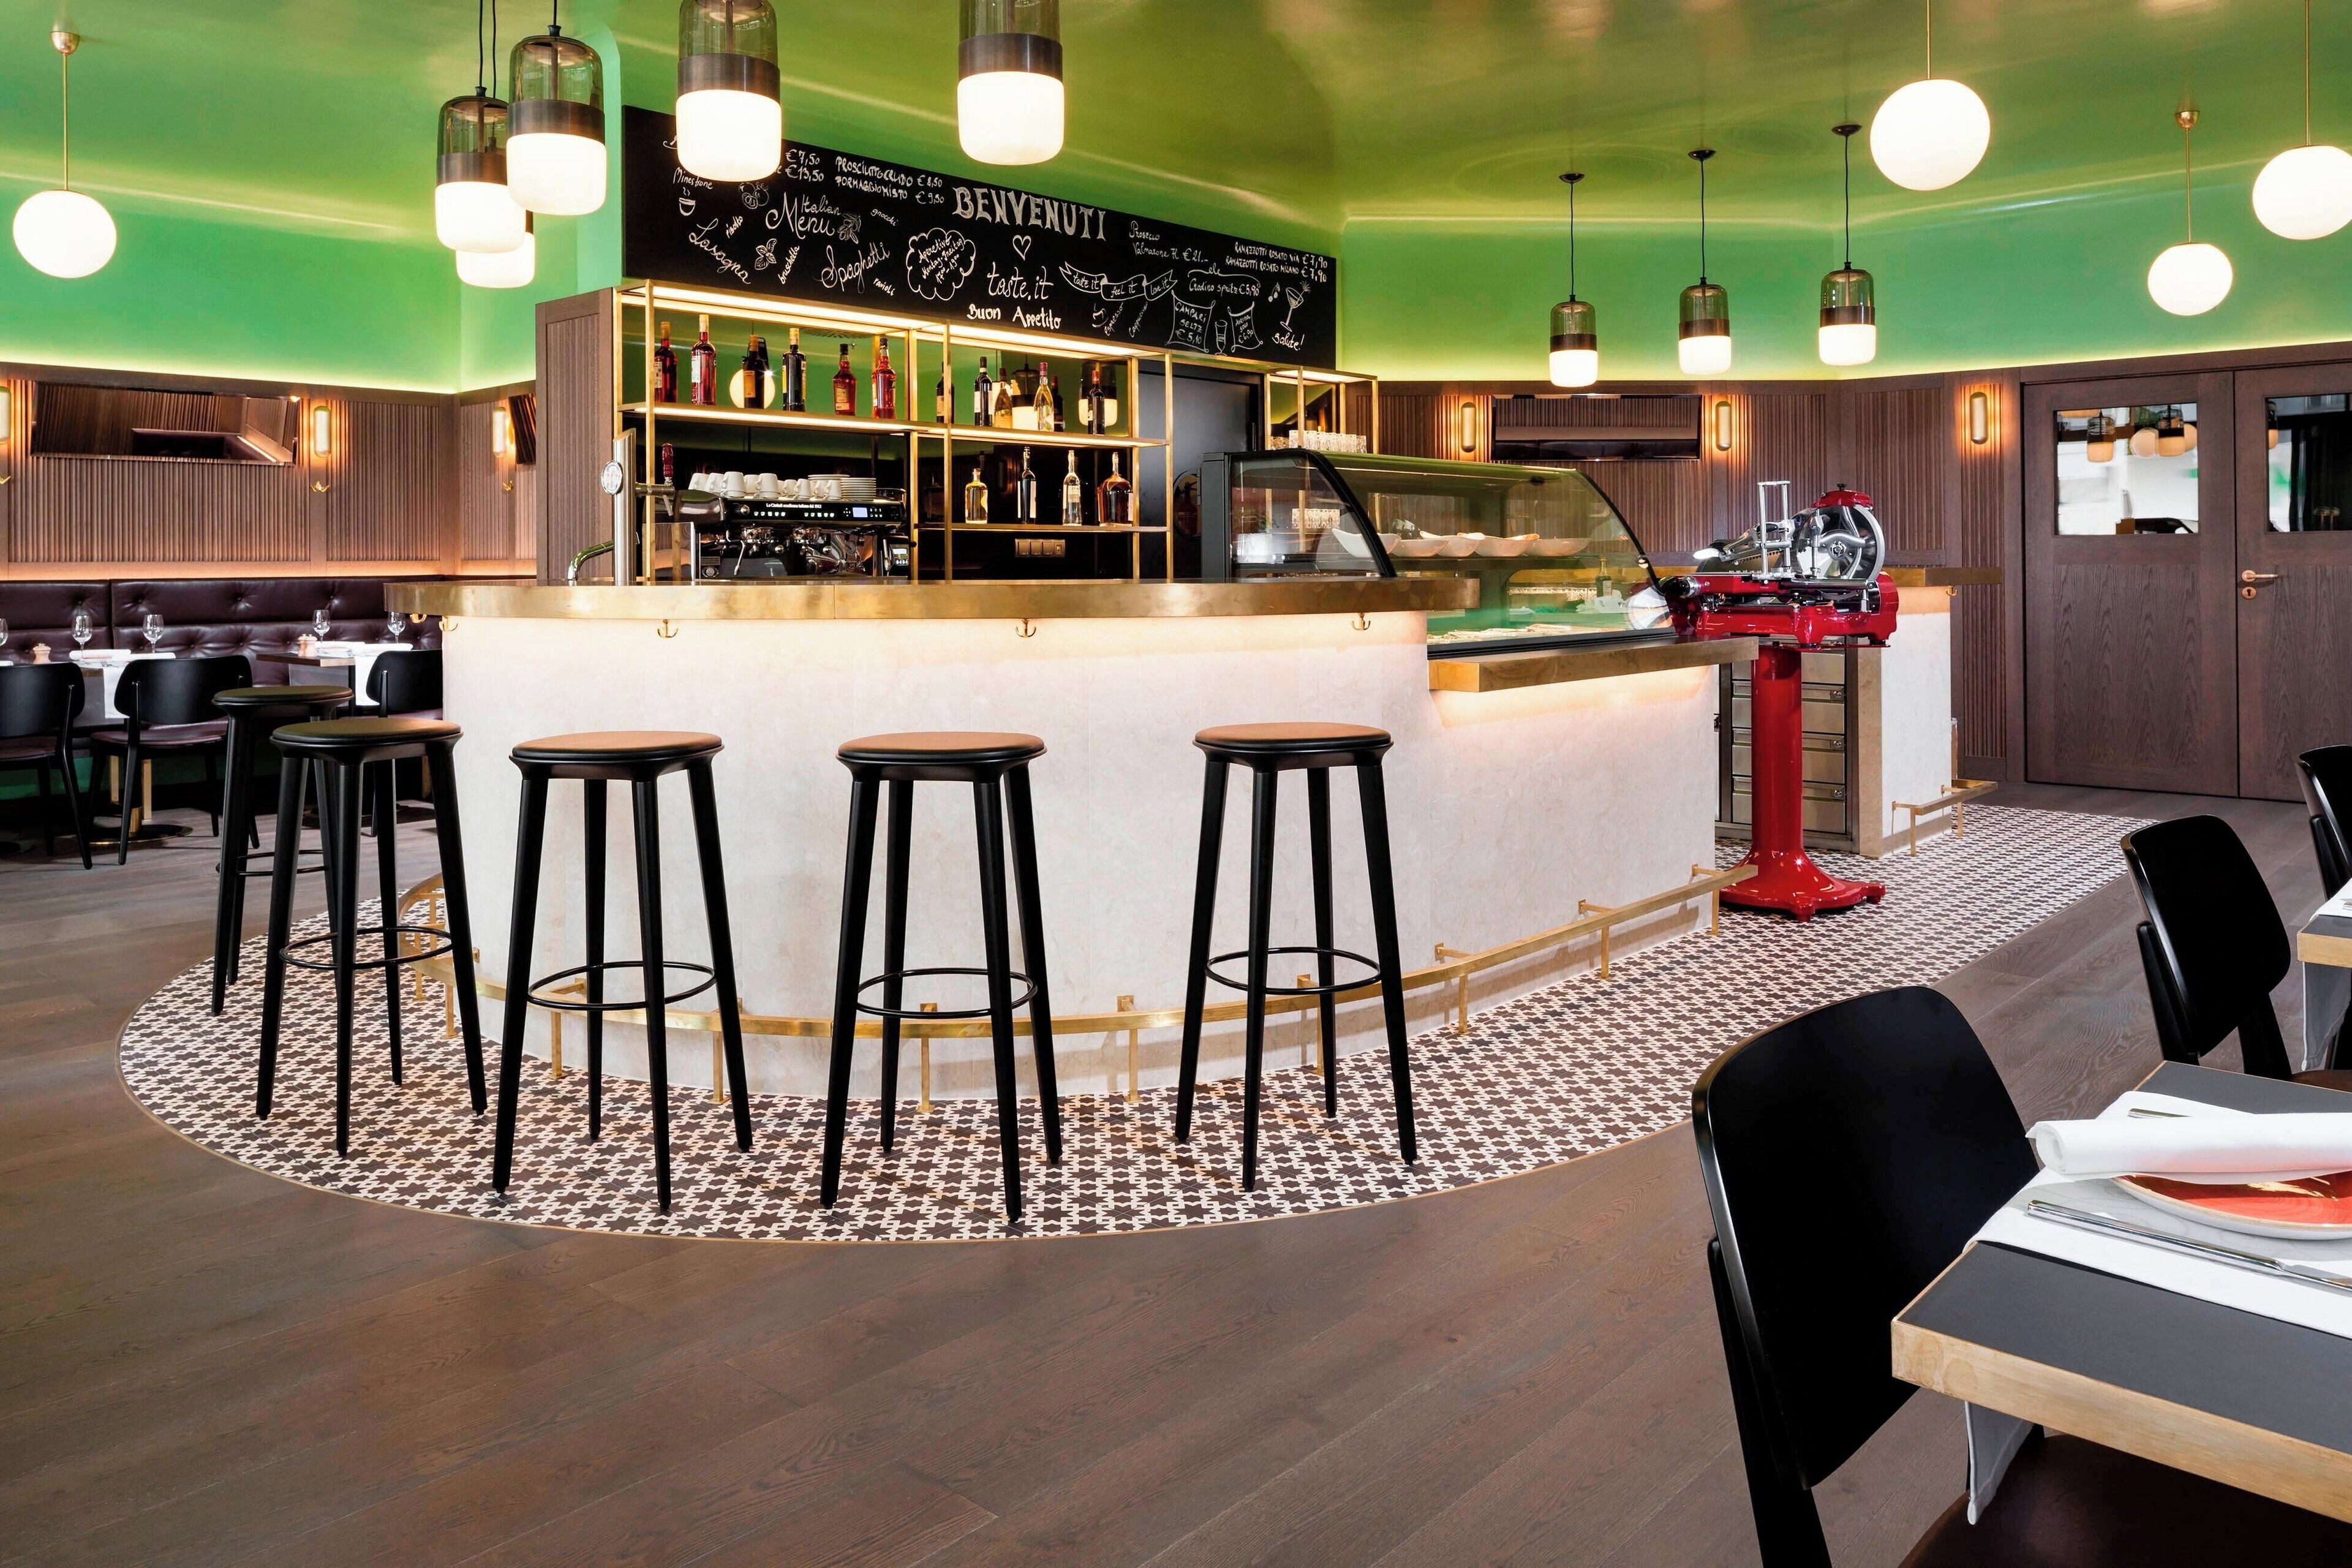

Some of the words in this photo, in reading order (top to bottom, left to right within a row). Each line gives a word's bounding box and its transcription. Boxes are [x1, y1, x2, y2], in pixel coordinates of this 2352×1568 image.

[673, 166, 714, 189] Minestrone
[765, 191, 835, 239] Menu
[801, 194, 842, 215] Italian
[952, 186, 1106, 242] BENVENUTI
[870, 208, 899, 227] gnocchi
[1129, 221, 1160, 241] Prosecco
[688, 217, 752, 285] Lasagna
[1268, 249, 1288, 261] ROSATO
[819, 241, 891, 294] Spaghetti
[1259, 261, 1280, 271] ROSATO
[1110, 284, 1126, 298] feel
[1128, 280, 1139, 293] it
[1216, 282, 1238, 297] spritz
[967, 303, 1001, 320] Buon
[1012, 306, 1061, 330] Appetito
